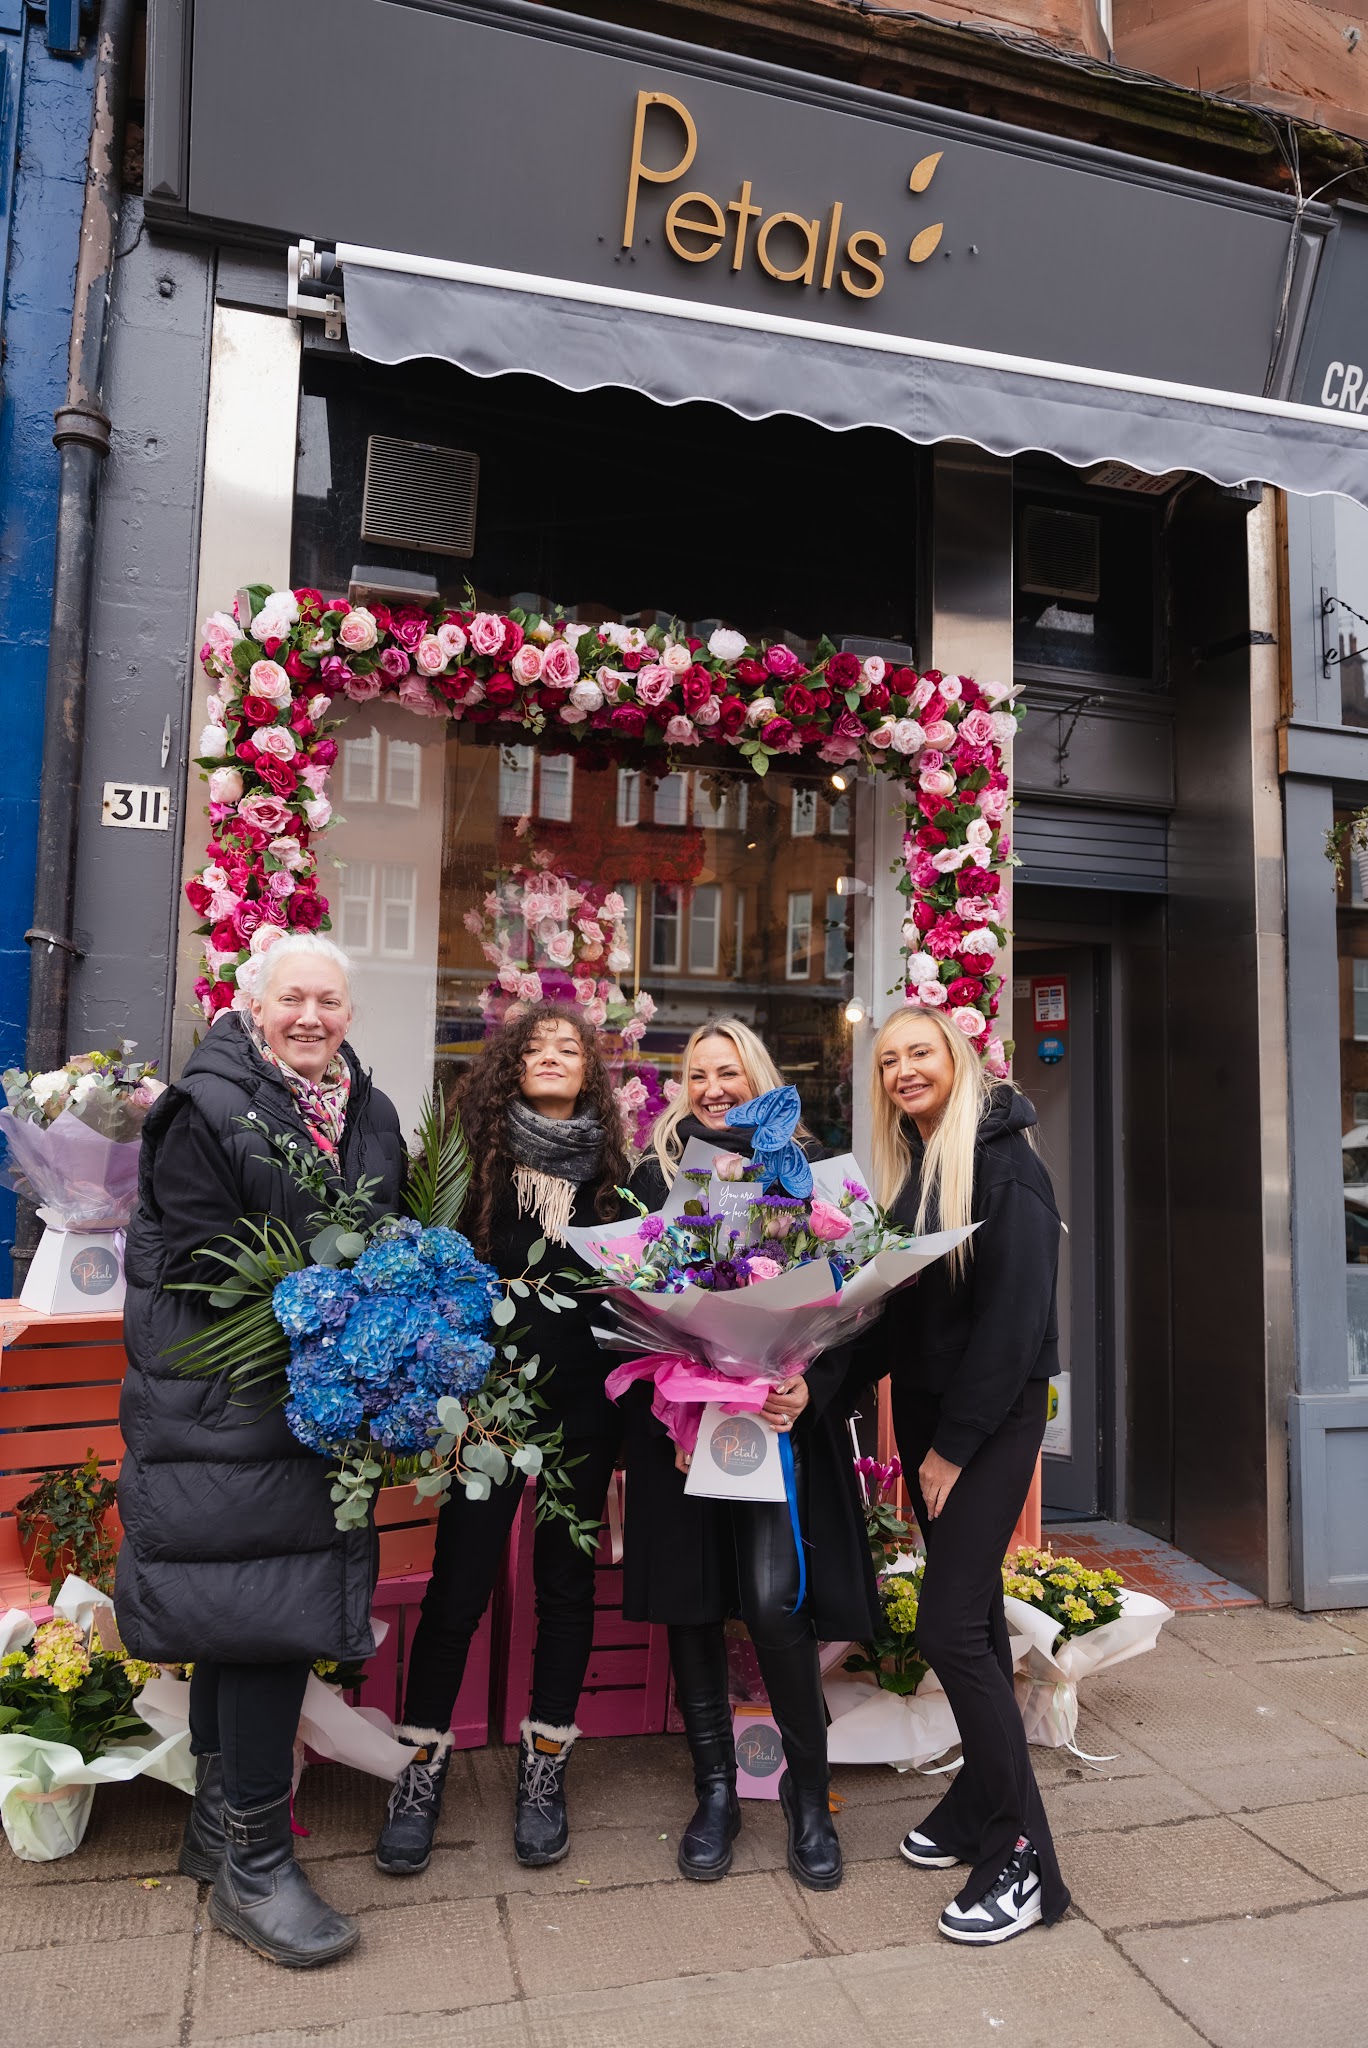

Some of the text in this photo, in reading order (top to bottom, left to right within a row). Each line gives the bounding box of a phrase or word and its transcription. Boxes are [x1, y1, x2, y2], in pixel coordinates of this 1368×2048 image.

[622, 90, 887, 299] Petals
[111, 788, 161, 824] 311
[718, 1184, 755, 1207] You are
[72, 1262, 113, 1287] Petals
[712, 1435, 760, 1464] Petals
[737, 1740, 778, 1768] Petals
